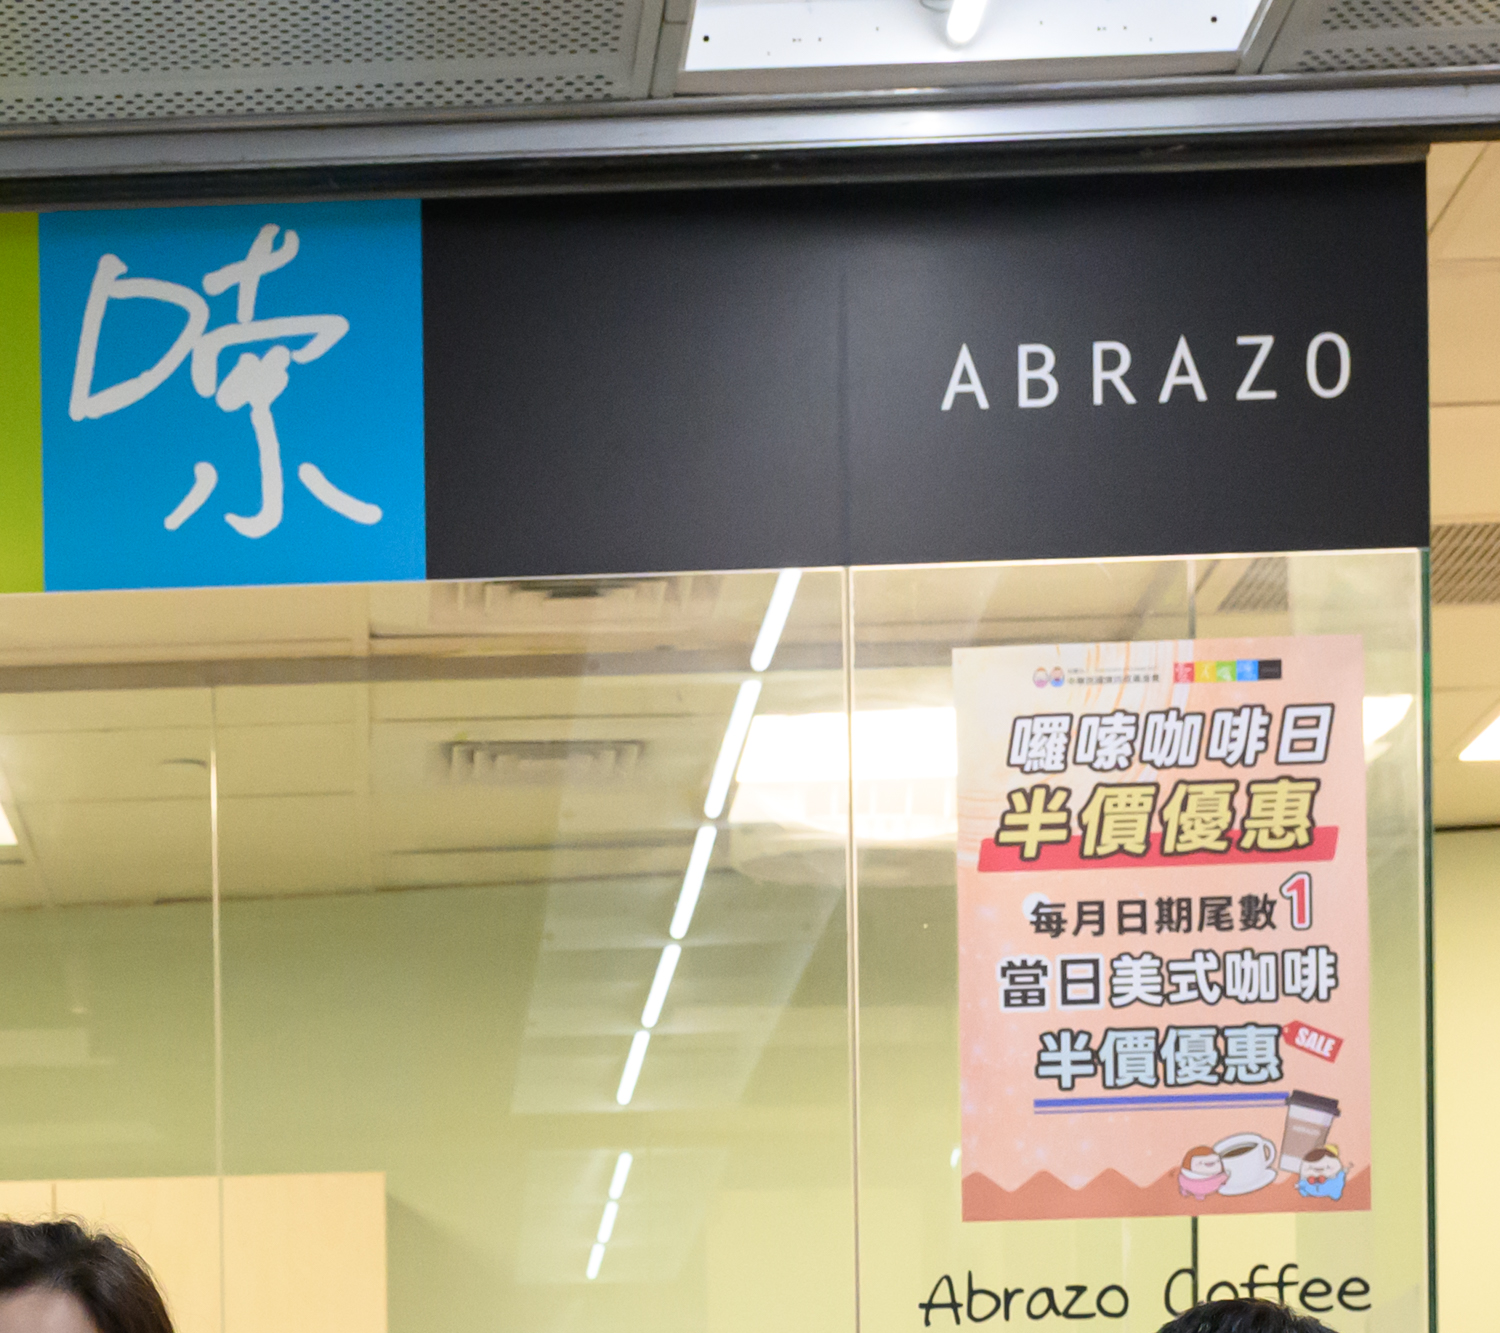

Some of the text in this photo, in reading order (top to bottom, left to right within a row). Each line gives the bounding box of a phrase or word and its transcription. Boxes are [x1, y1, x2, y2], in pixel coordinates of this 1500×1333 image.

[940, 331, 1352, 412] ABRAZO
[1007, 702, 1335, 775] 囉嗦咖啡日
[995, 776, 1322, 862] 半價優惠
[997, 945, 1339, 1012] 當日美式咖啡
[1034, 1021, 1285, 1091] 半價優惠
[1294, 1027, 1337, 1058] SALE
[918, 1270, 1130, 1327] Abrazo
